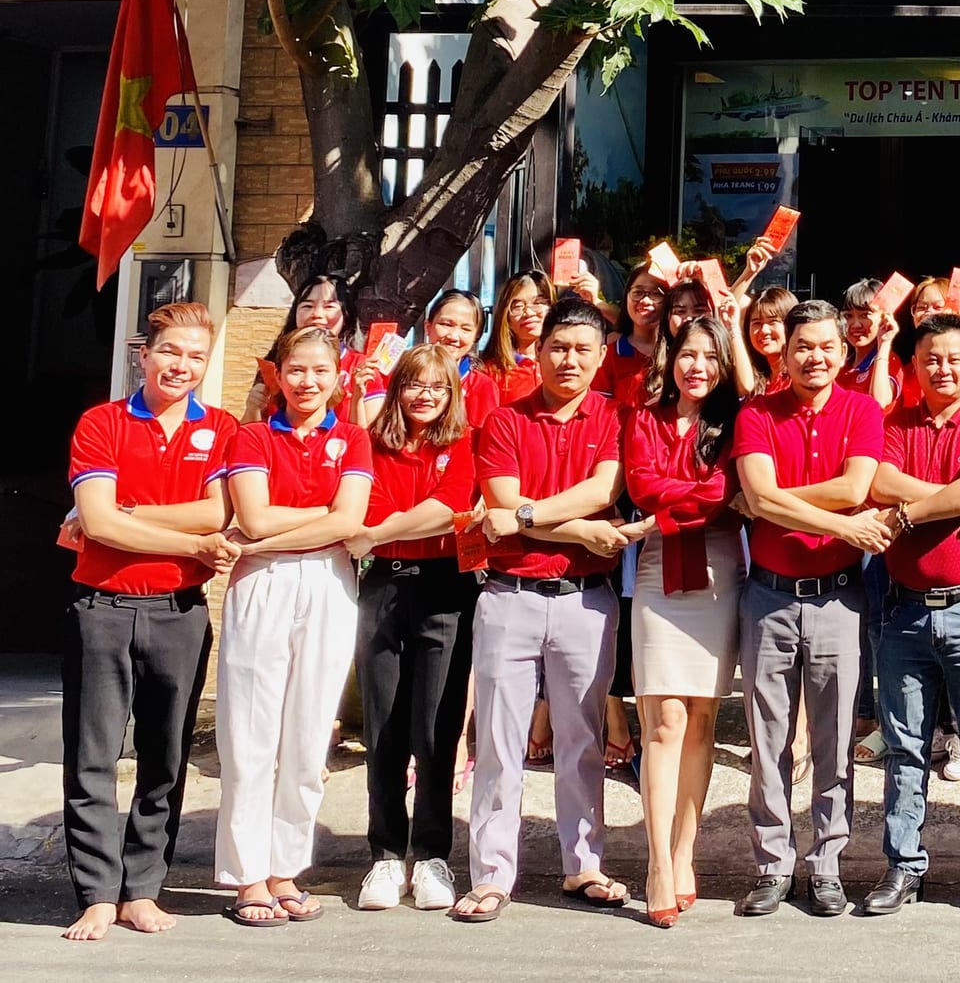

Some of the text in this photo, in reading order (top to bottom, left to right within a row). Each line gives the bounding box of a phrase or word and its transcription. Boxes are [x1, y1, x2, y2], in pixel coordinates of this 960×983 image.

[844, 81, 893, 101] TOP
[898, 80, 945, 101] TEN
[887, 111, 912, 124] Châu
[915, 110, 923, 123] Á
[932, 111, 960, 123] Khám
